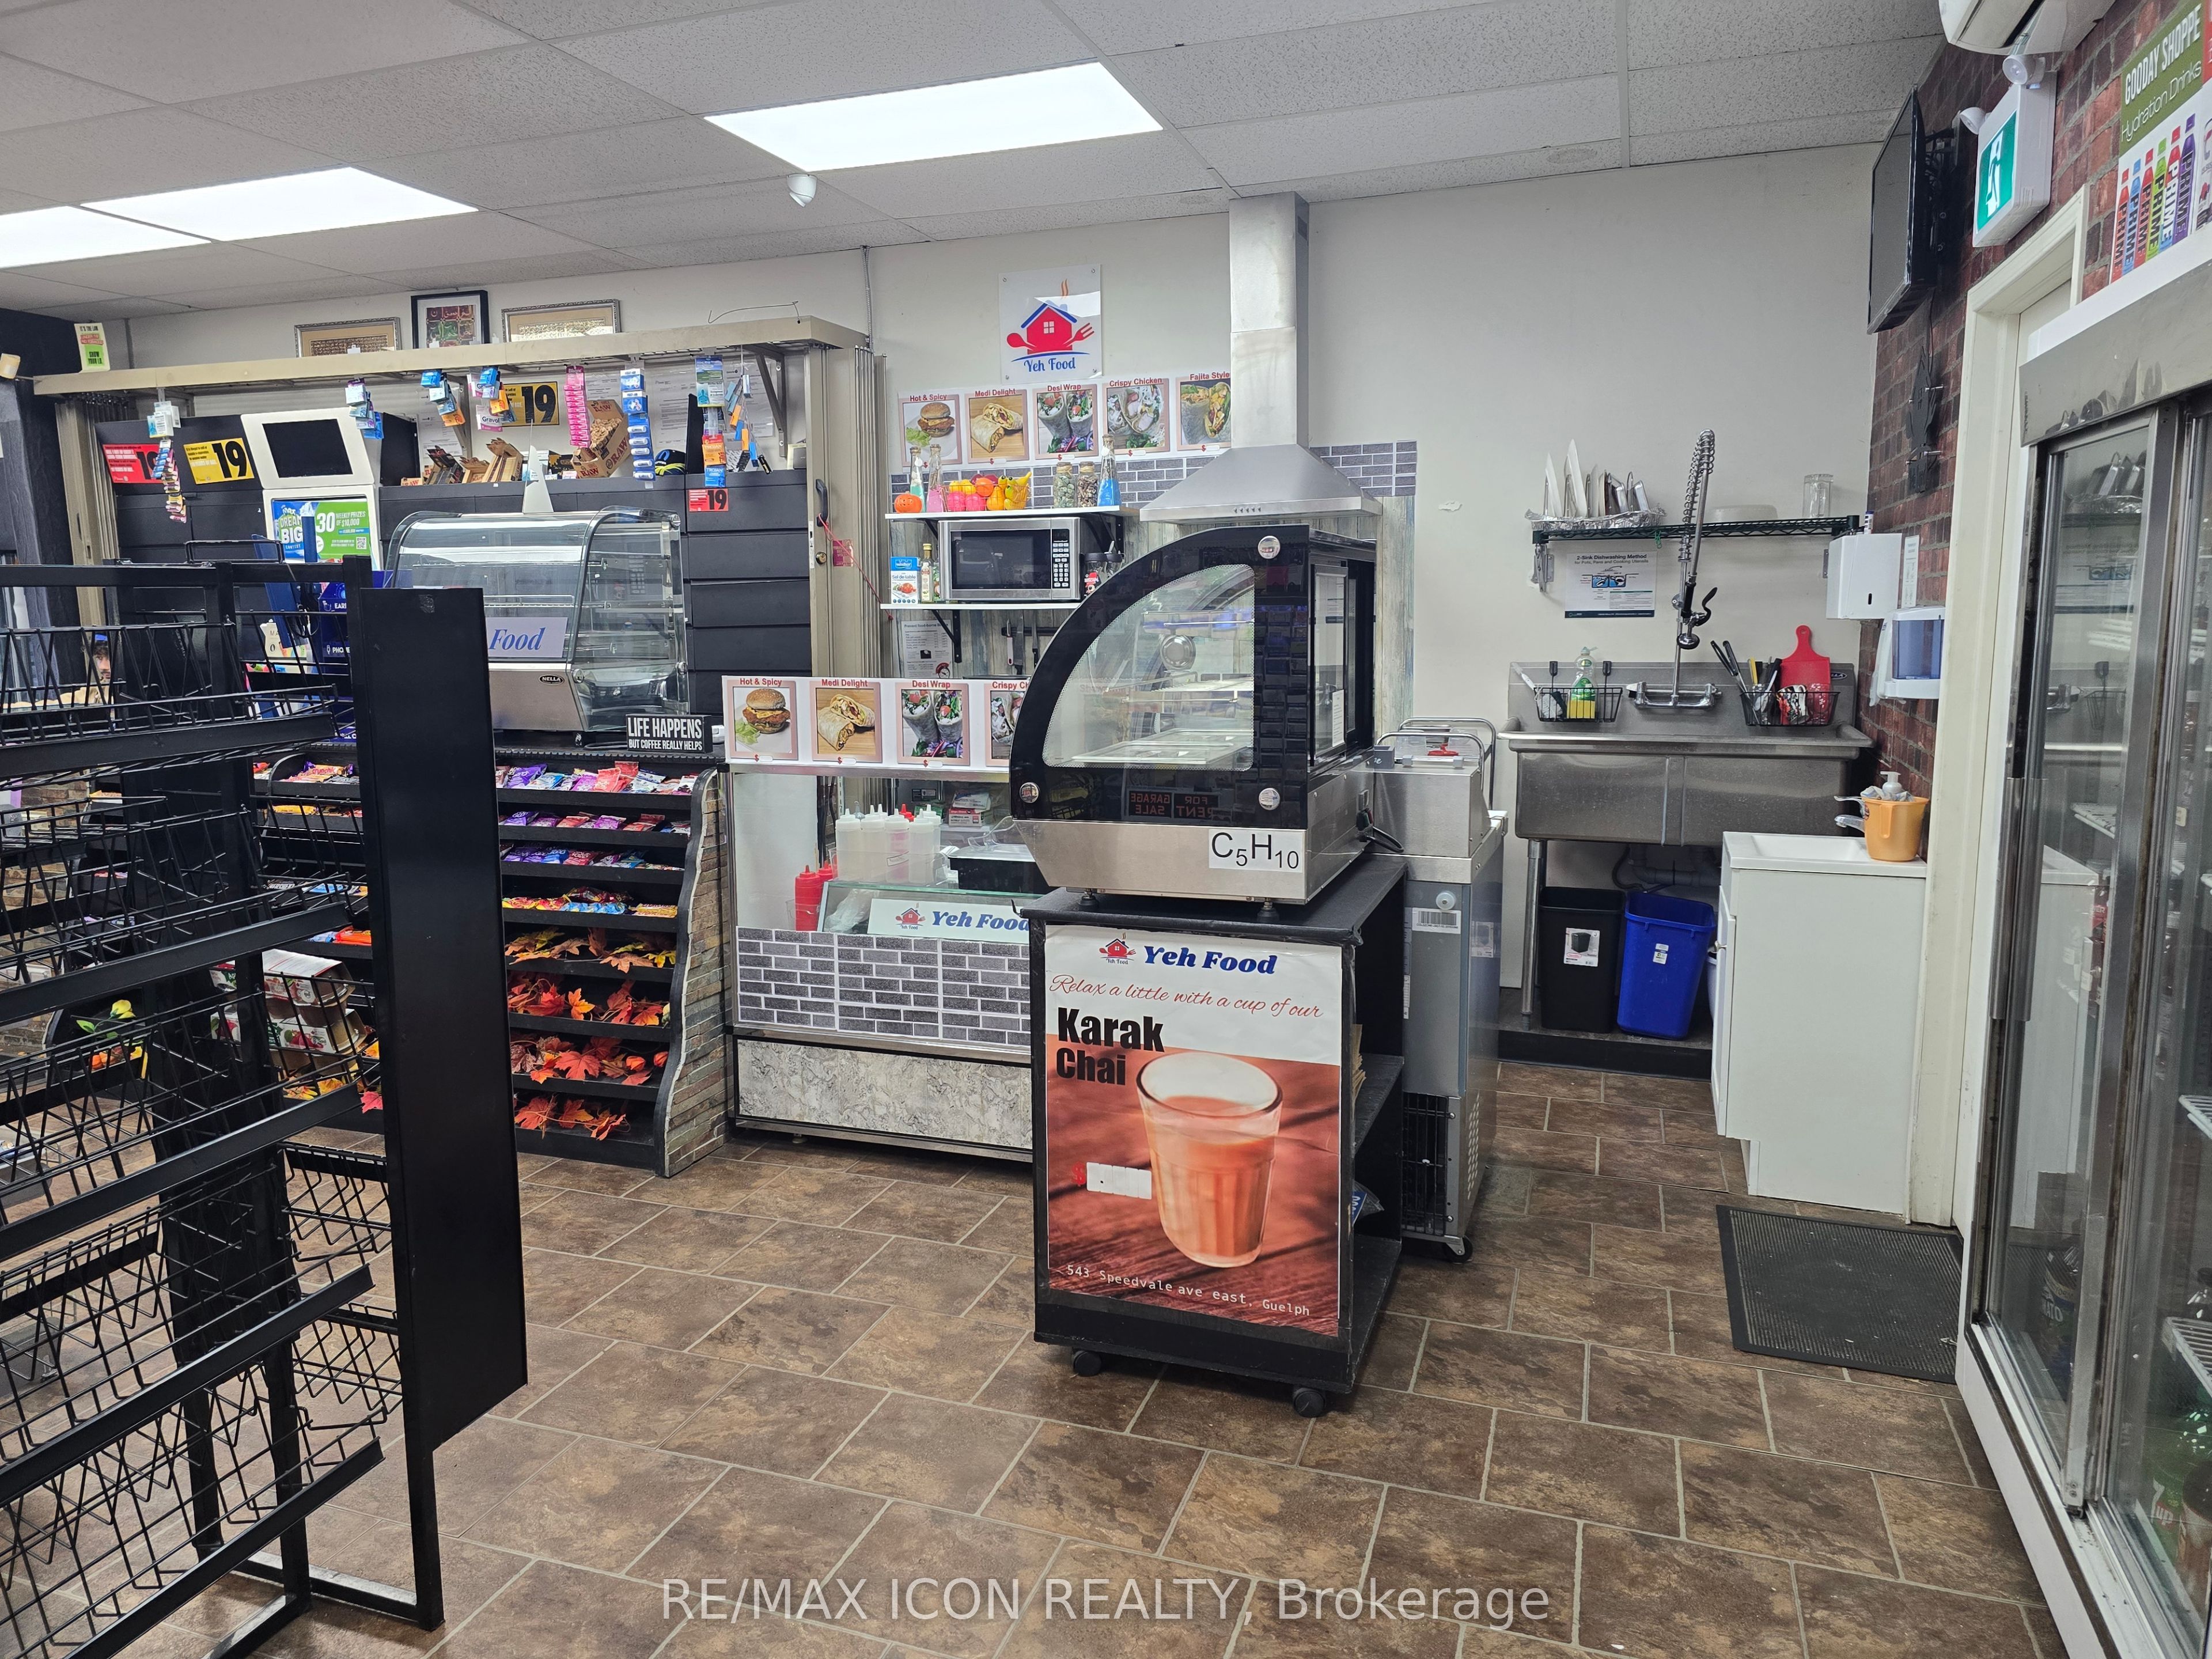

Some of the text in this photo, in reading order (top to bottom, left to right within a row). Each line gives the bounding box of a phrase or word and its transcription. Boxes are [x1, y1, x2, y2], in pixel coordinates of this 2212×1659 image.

[2125, 3, 2202, 105] GOODAY SHOPPE
[2122, 60, 2202, 142] Hydration Drinks
[2161, 161, 2179, 245] PRIME
[2175, 150, 2194, 234] PRIME
[2137, 184, 2152, 260] PRIME
[2149, 173, 2165, 251] PRIME
[2113, 203, 2128, 275] PRIME
[2124, 192, 2139, 268] PRIME
[1024, 357, 1075, 372] Yeh Food
[521, 385, 556, 423] 19
[993, 388, 1016, 397] Delight
[211, 441, 248, 478] 19
[611, 437, 627, 465] RAW
[580, 468, 599, 476] RAW
[707, 489, 727, 510] 19
[281, 527, 302, 544] BIG
[316, 512, 335, 533] 30
[488, 627, 546, 650] Food
[762, 678, 782, 687] Spicy
[842, 679, 868, 688] Delight
[931, 680, 950, 689] Wrap
[992, 681, 1017, 690] Crispy
[627, 717, 702, 738] LIFE HAPPENS
[628, 738, 702, 751] BUT COFFEE REALLY HELPS
[932, 911, 972, 927] Yeh
[1144, 945, 1278, 974] Yeh Food
[1049, 974, 1324, 1018] Relax a little with a cup of our
[1058, 1007, 1165, 1052] Karak
[1056, 1047, 1126, 1085] Chai
[1072, 1161, 1086, 1187] $
[1066, 1264, 1310, 1316] 543 Speedvale ave east, Guelph
